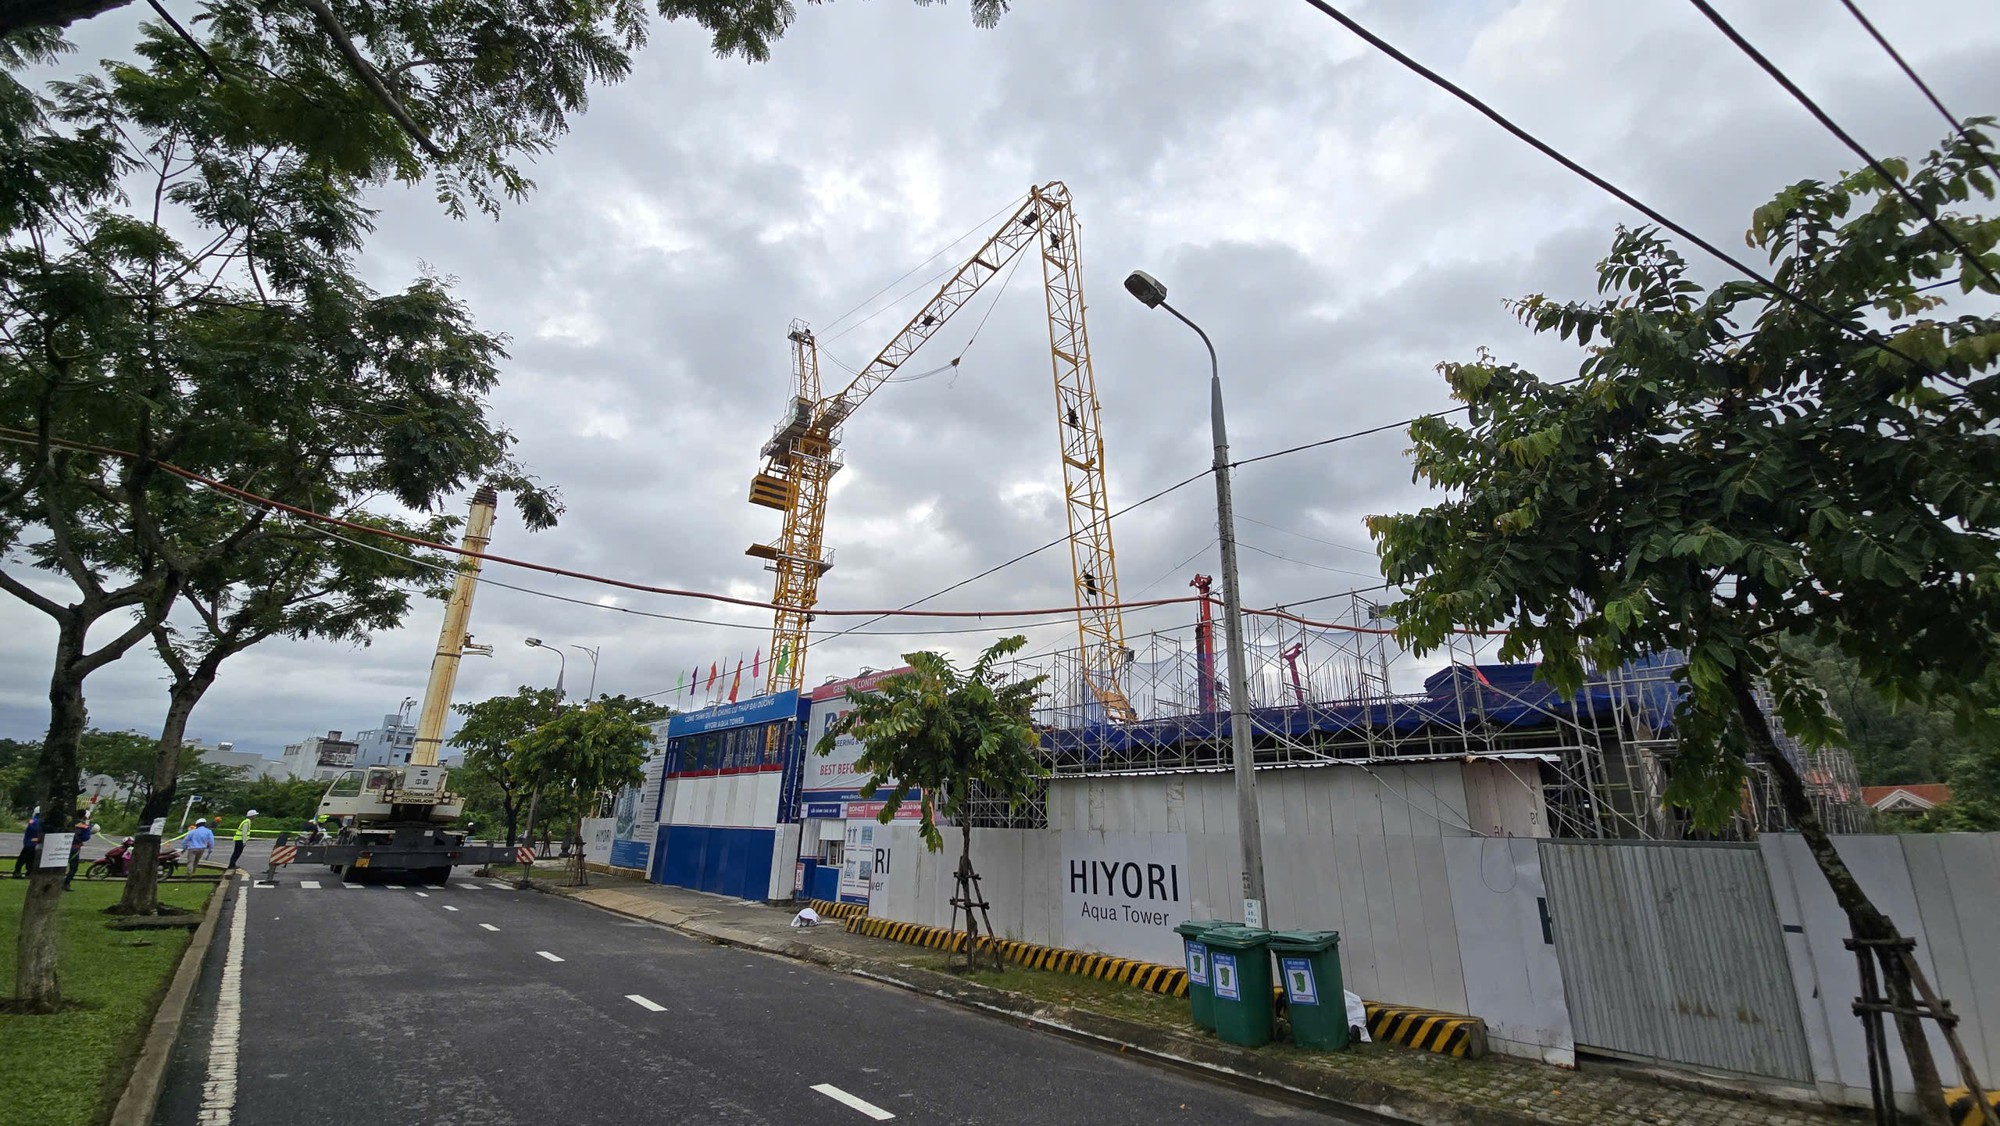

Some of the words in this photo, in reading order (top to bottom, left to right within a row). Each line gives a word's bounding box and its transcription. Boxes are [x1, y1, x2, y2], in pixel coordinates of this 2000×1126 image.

[820, 764, 836, 776] BEST
[837, 762, 855, 774] BEFO
[1070, 860, 1179, 902] HIYORI
[1081, 901, 1117, 922] Aqua
[1122, 904, 1169, 926] Tower
